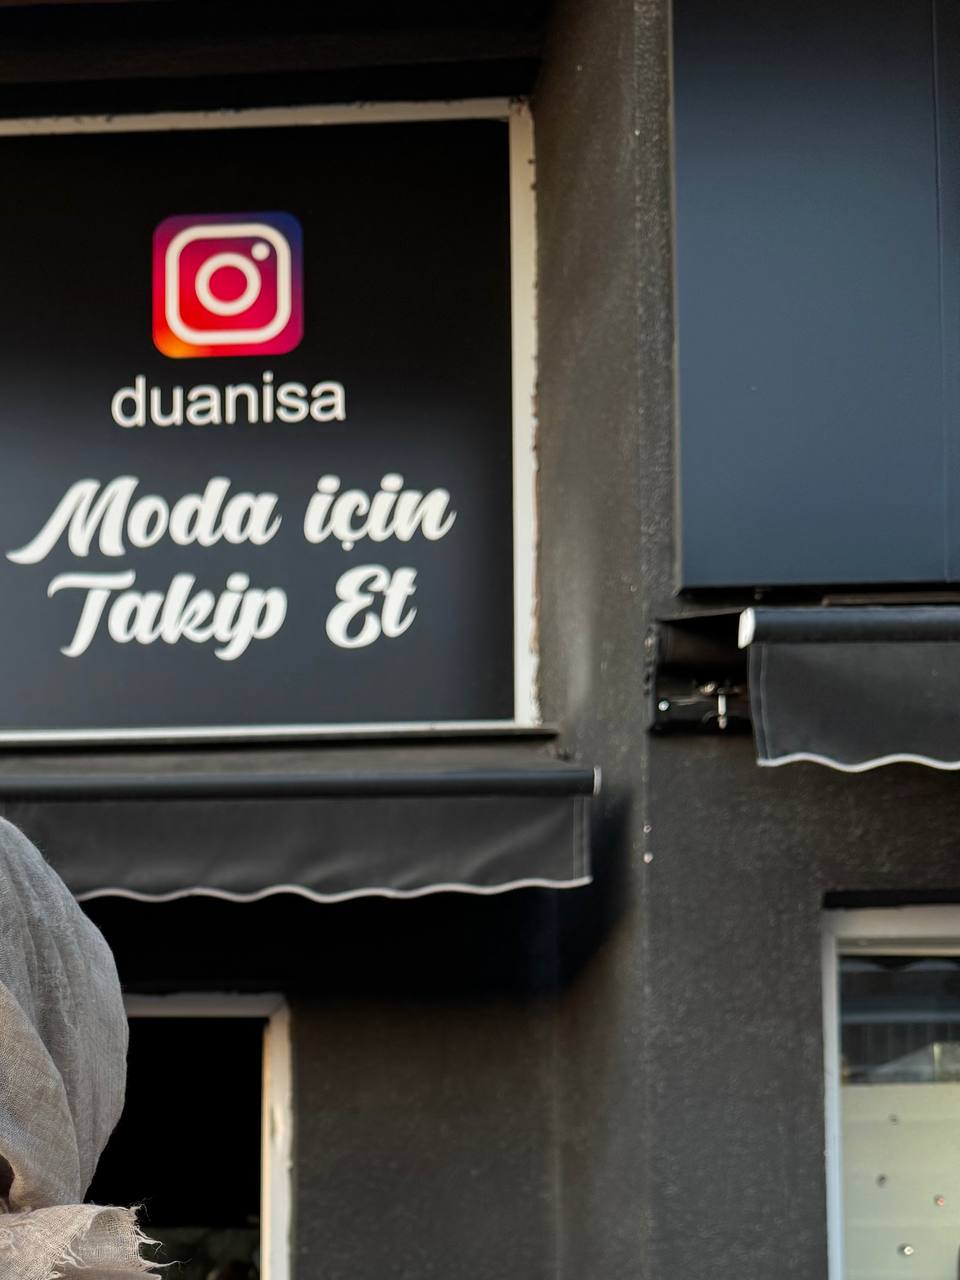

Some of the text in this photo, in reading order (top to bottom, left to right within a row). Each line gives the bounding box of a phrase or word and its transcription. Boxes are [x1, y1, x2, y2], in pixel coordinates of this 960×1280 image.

[111, 371, 346, 429] duanisa
[5, 473, 458, 565] Moda için
[47, 564, 418, 661] Takip Et
